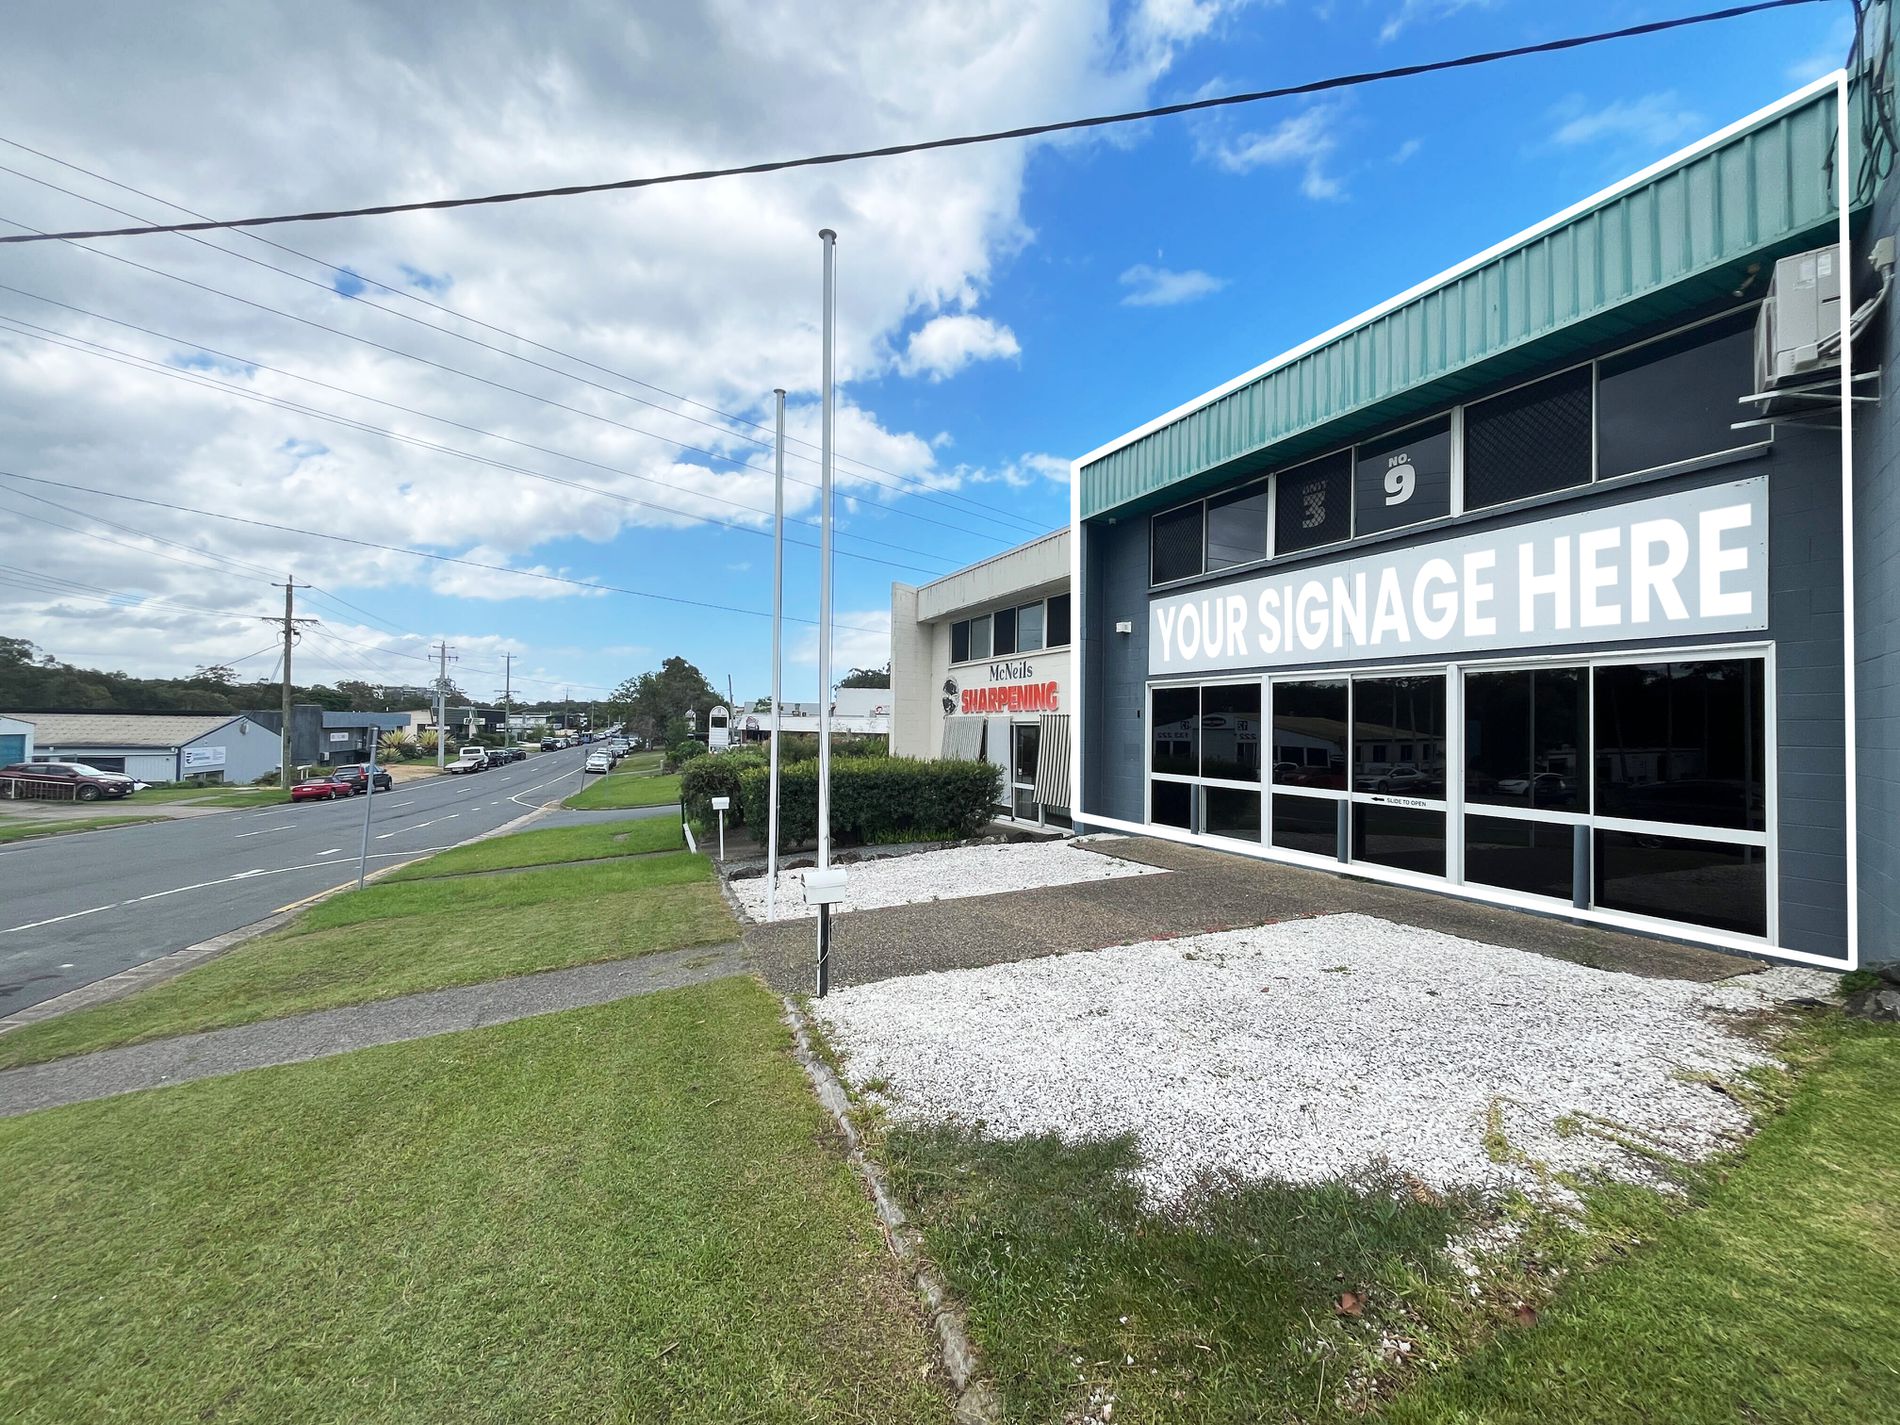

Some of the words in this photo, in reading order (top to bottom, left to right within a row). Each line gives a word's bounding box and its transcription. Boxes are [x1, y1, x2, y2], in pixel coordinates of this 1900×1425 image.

[1388, 453, 1412, 467] NO.
[1384, 464, 1416, 506] 9
[1302, 490, 1326, 528] 3
[989, 660, 1033, 682] McNeils
[961, 681, 1059, 714] SHARPENING
[1387, 797, 1402, 805] SLIDE
